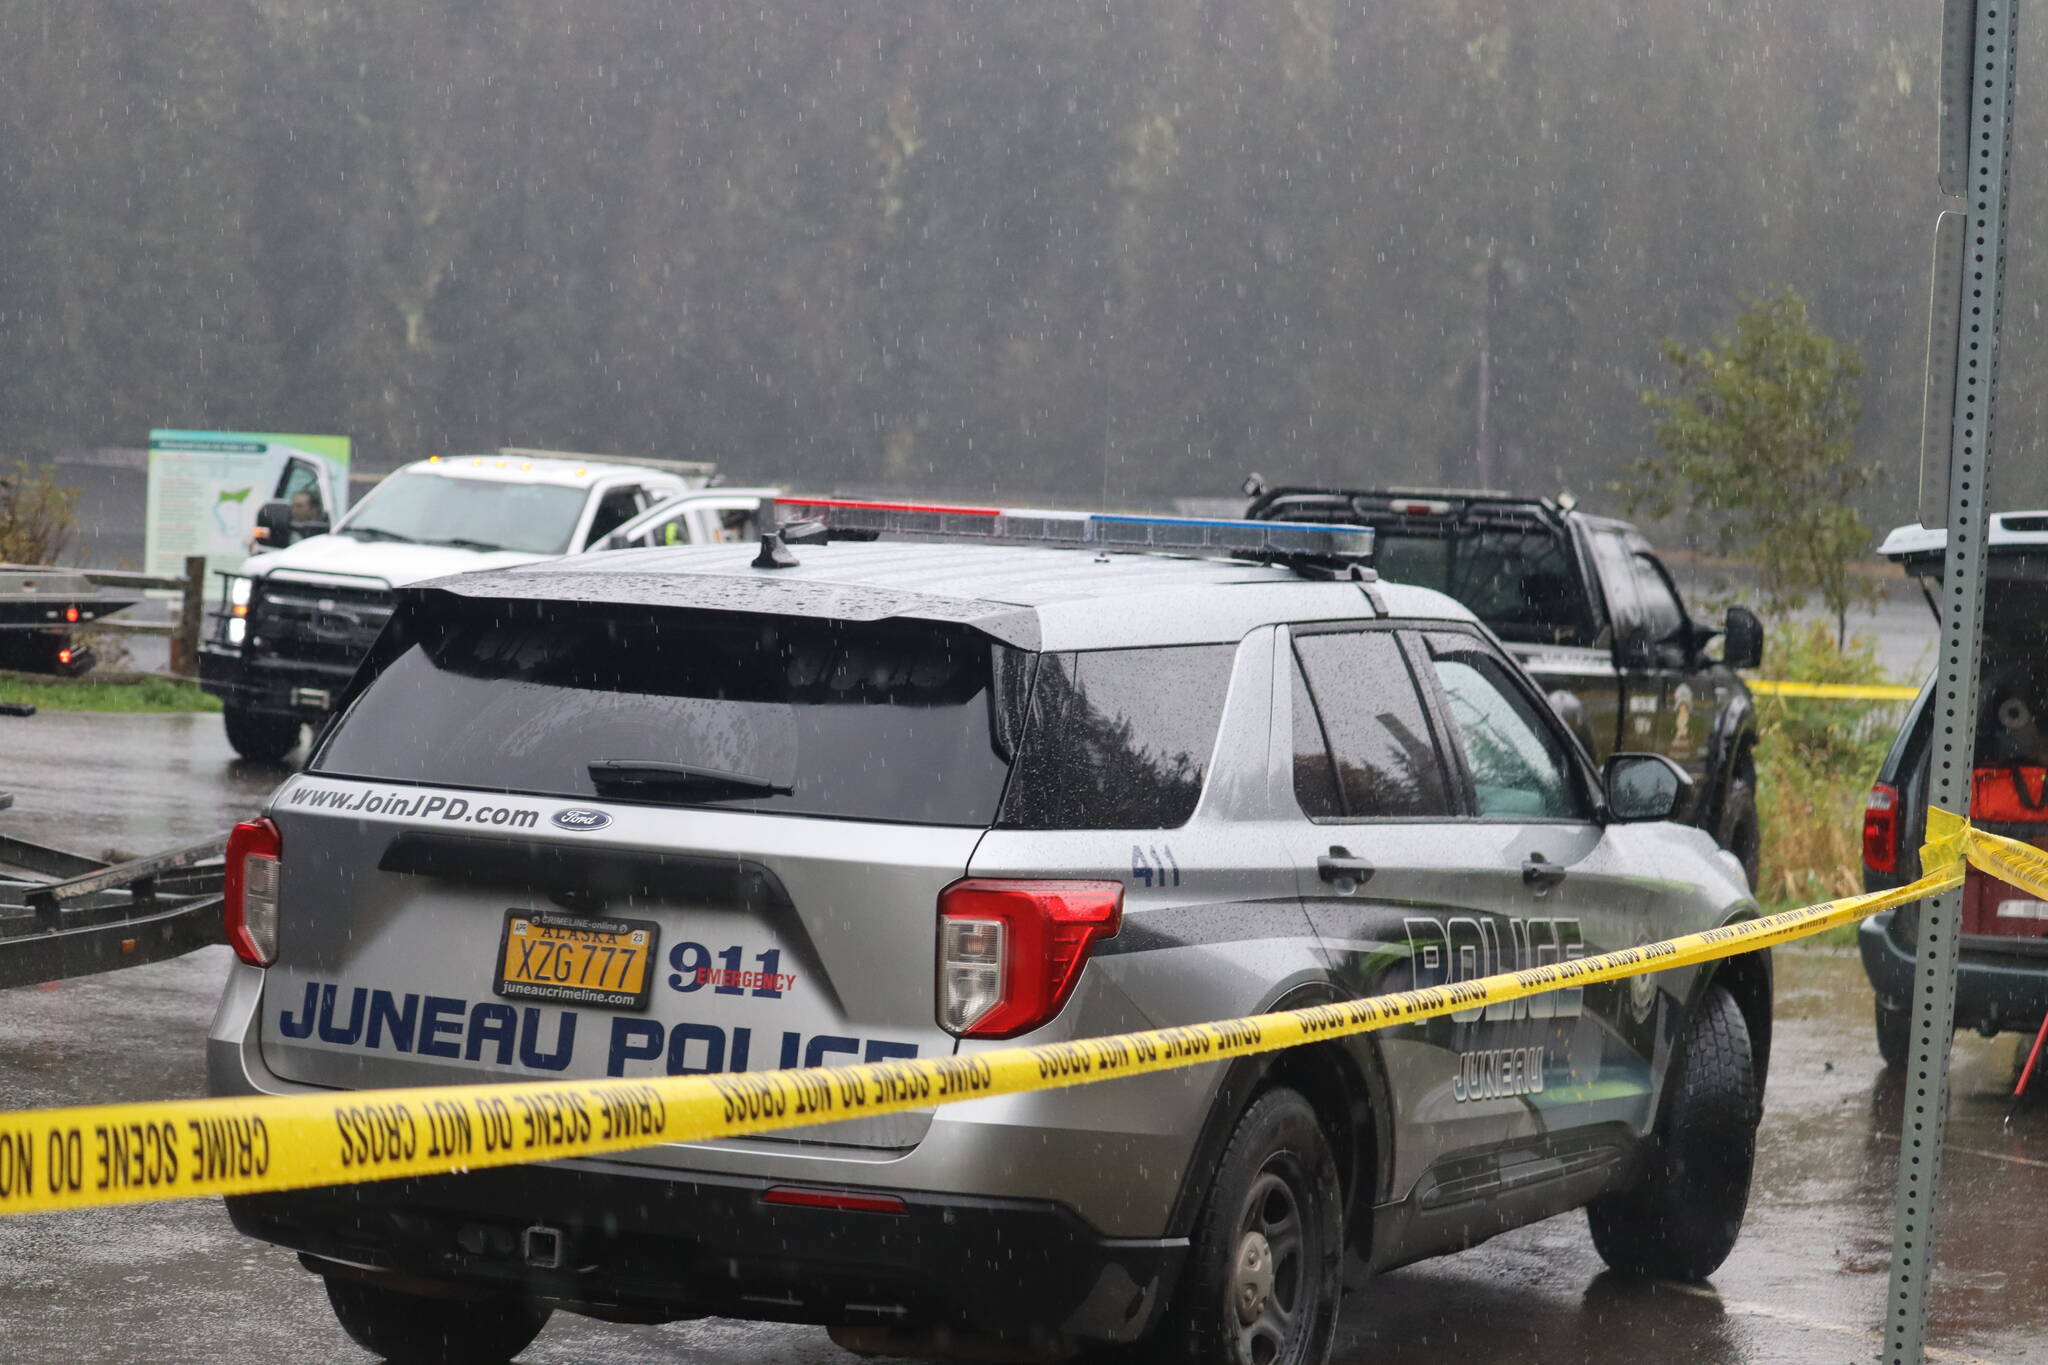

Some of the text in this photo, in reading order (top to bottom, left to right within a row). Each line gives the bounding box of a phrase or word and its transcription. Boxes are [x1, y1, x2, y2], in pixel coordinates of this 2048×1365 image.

[290, 788, 540, 828] www.JoinJPD.com
[560, 810, 596, 826] Ford
[1132, 845, 1180, 887] 411
[632, 932, 643, 943] 23
[516, 938, 637, 988] XZG 777
[668, 942, 783, 999] 911
[695, 967, 797, 991] EMERGENCY
[501, 981, 635, 1005] juneaucrimeline.com
[279, 982, 578, 1071] JUNEAU
[788, 1069, 832, 1114] NOT
[830, 1067, 866, 1108] DO
[1452, 1046, 1544, 1103] JUNEAU
[334, 1084, 666, 1167] CRIME SCENE DO NOT CROSS
[0, 1115, 270, 1199] CRIME SCENE DO NO
